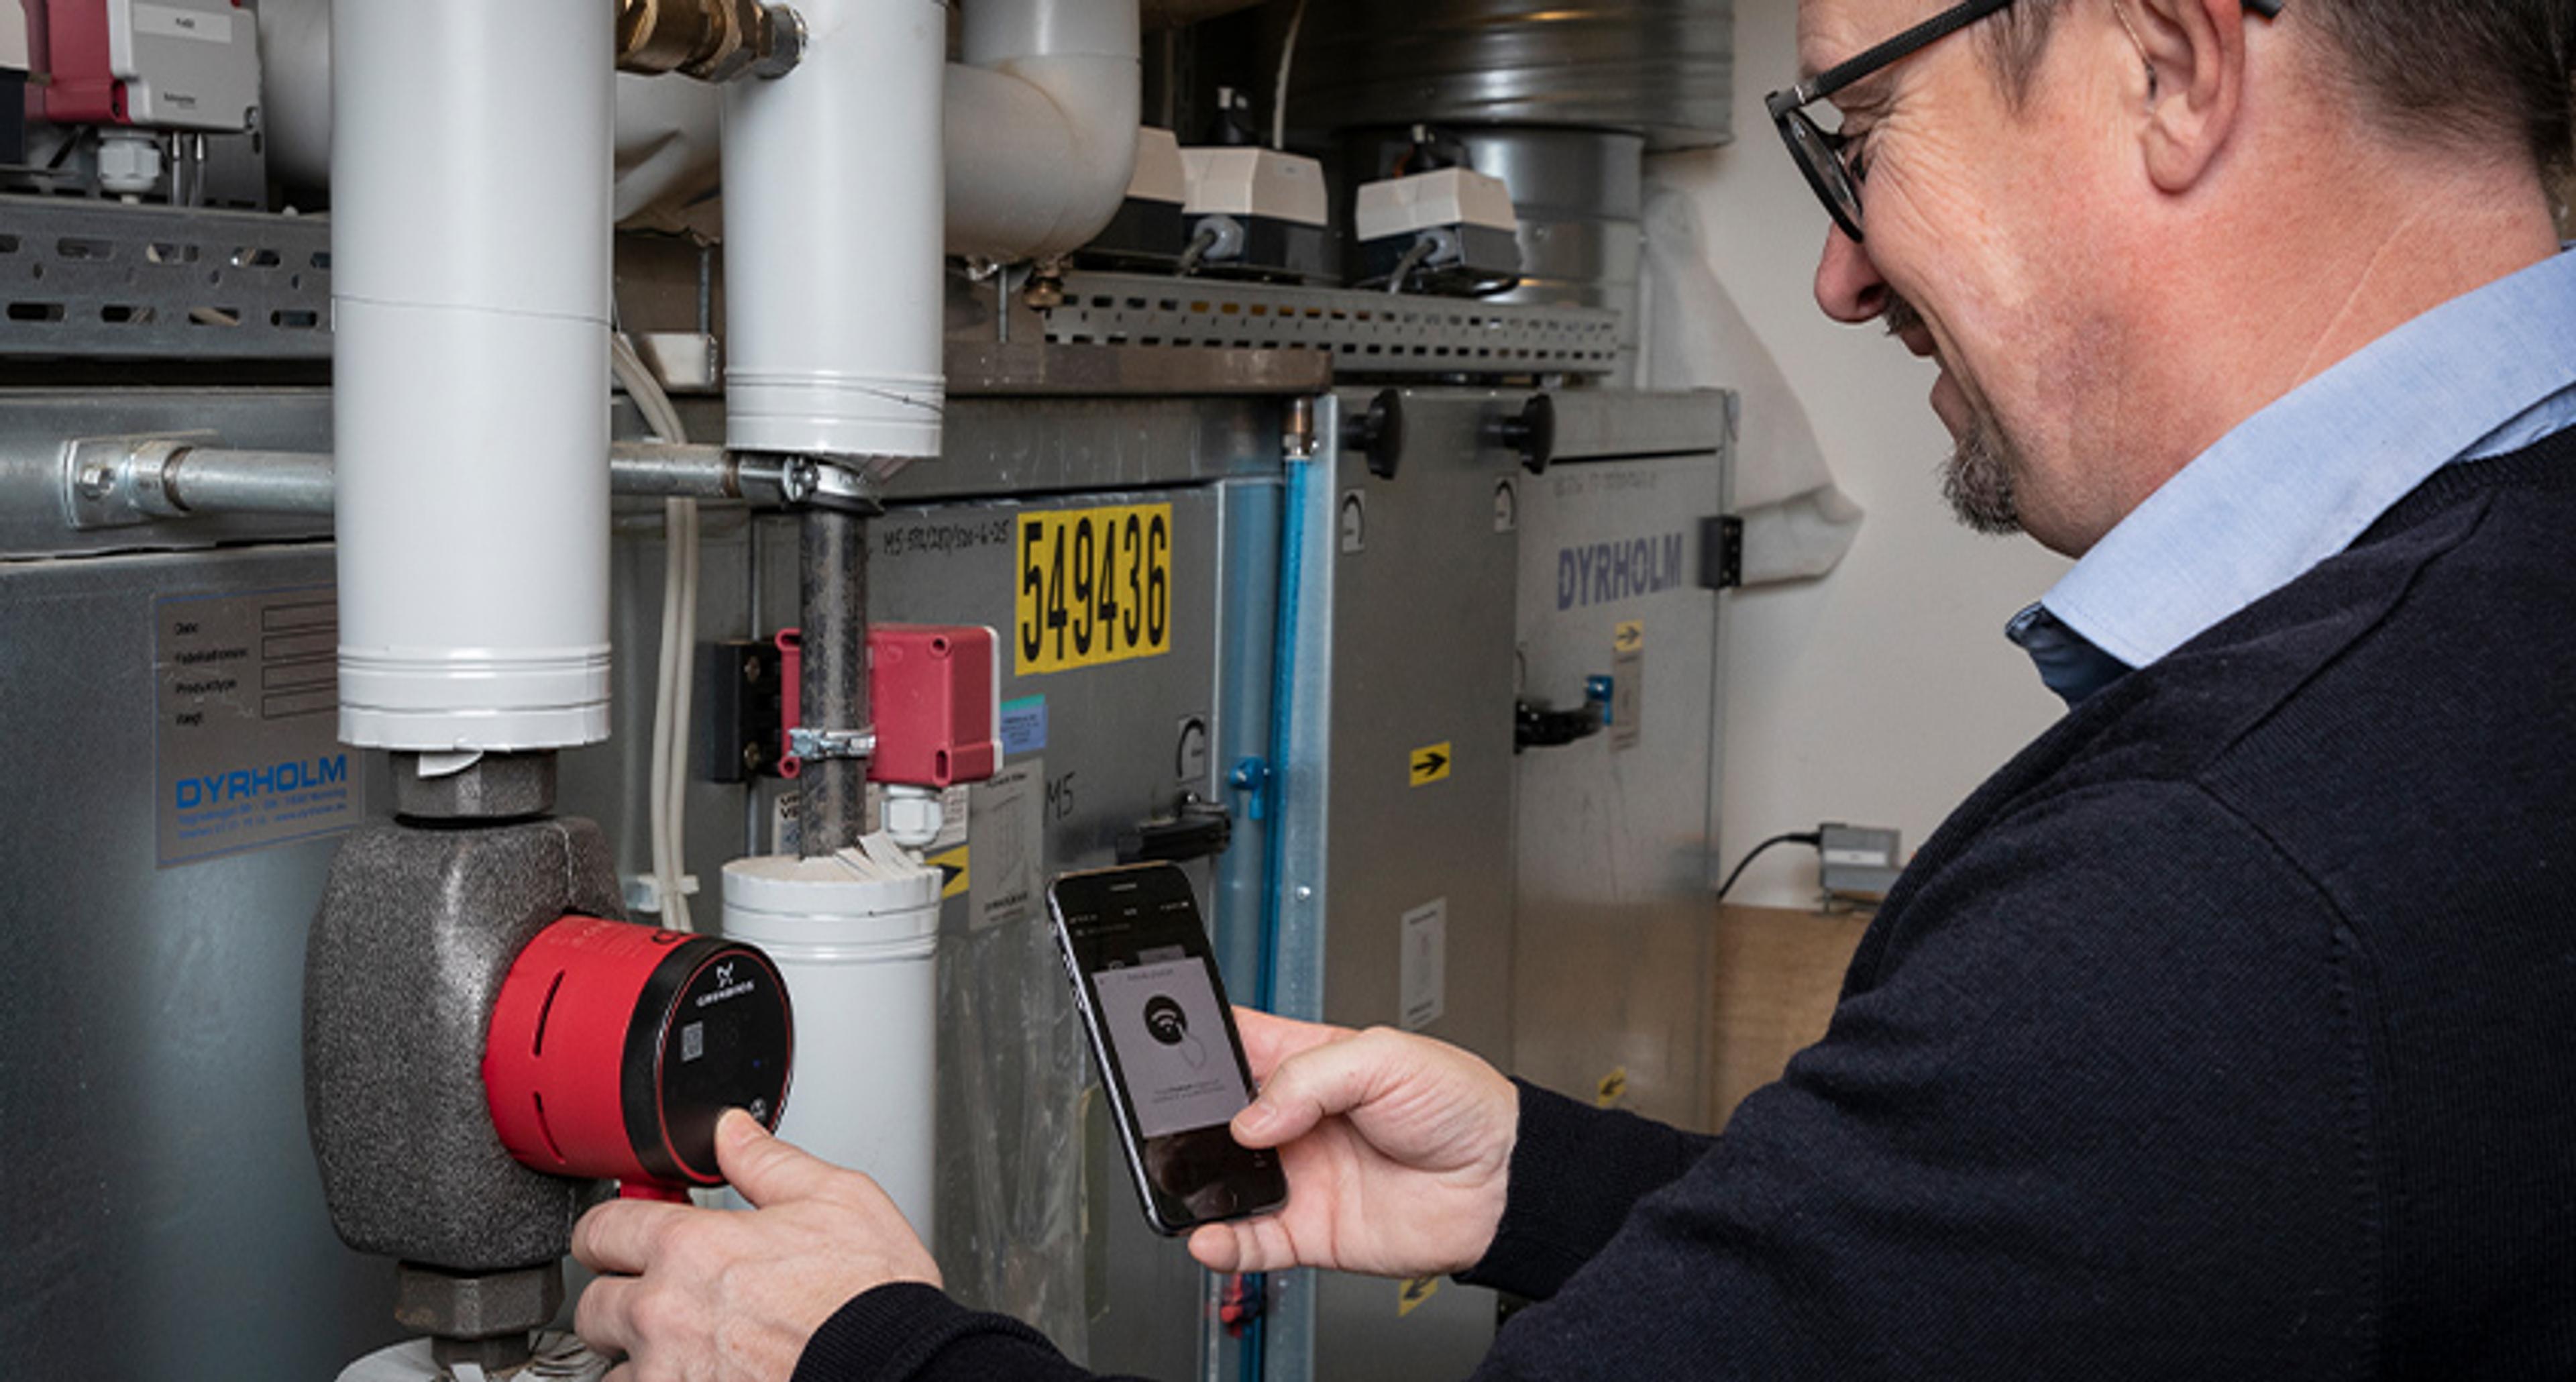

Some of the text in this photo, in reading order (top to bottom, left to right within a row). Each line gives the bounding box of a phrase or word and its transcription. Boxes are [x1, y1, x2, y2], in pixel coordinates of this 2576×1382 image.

[1023, 514, 1166, 662] 549436
[1558, 534, 1682, 610] DYRHOLM
[176, 754, 347, 809] DYRHOLM
[1044, 771, 1075, 825] M5
